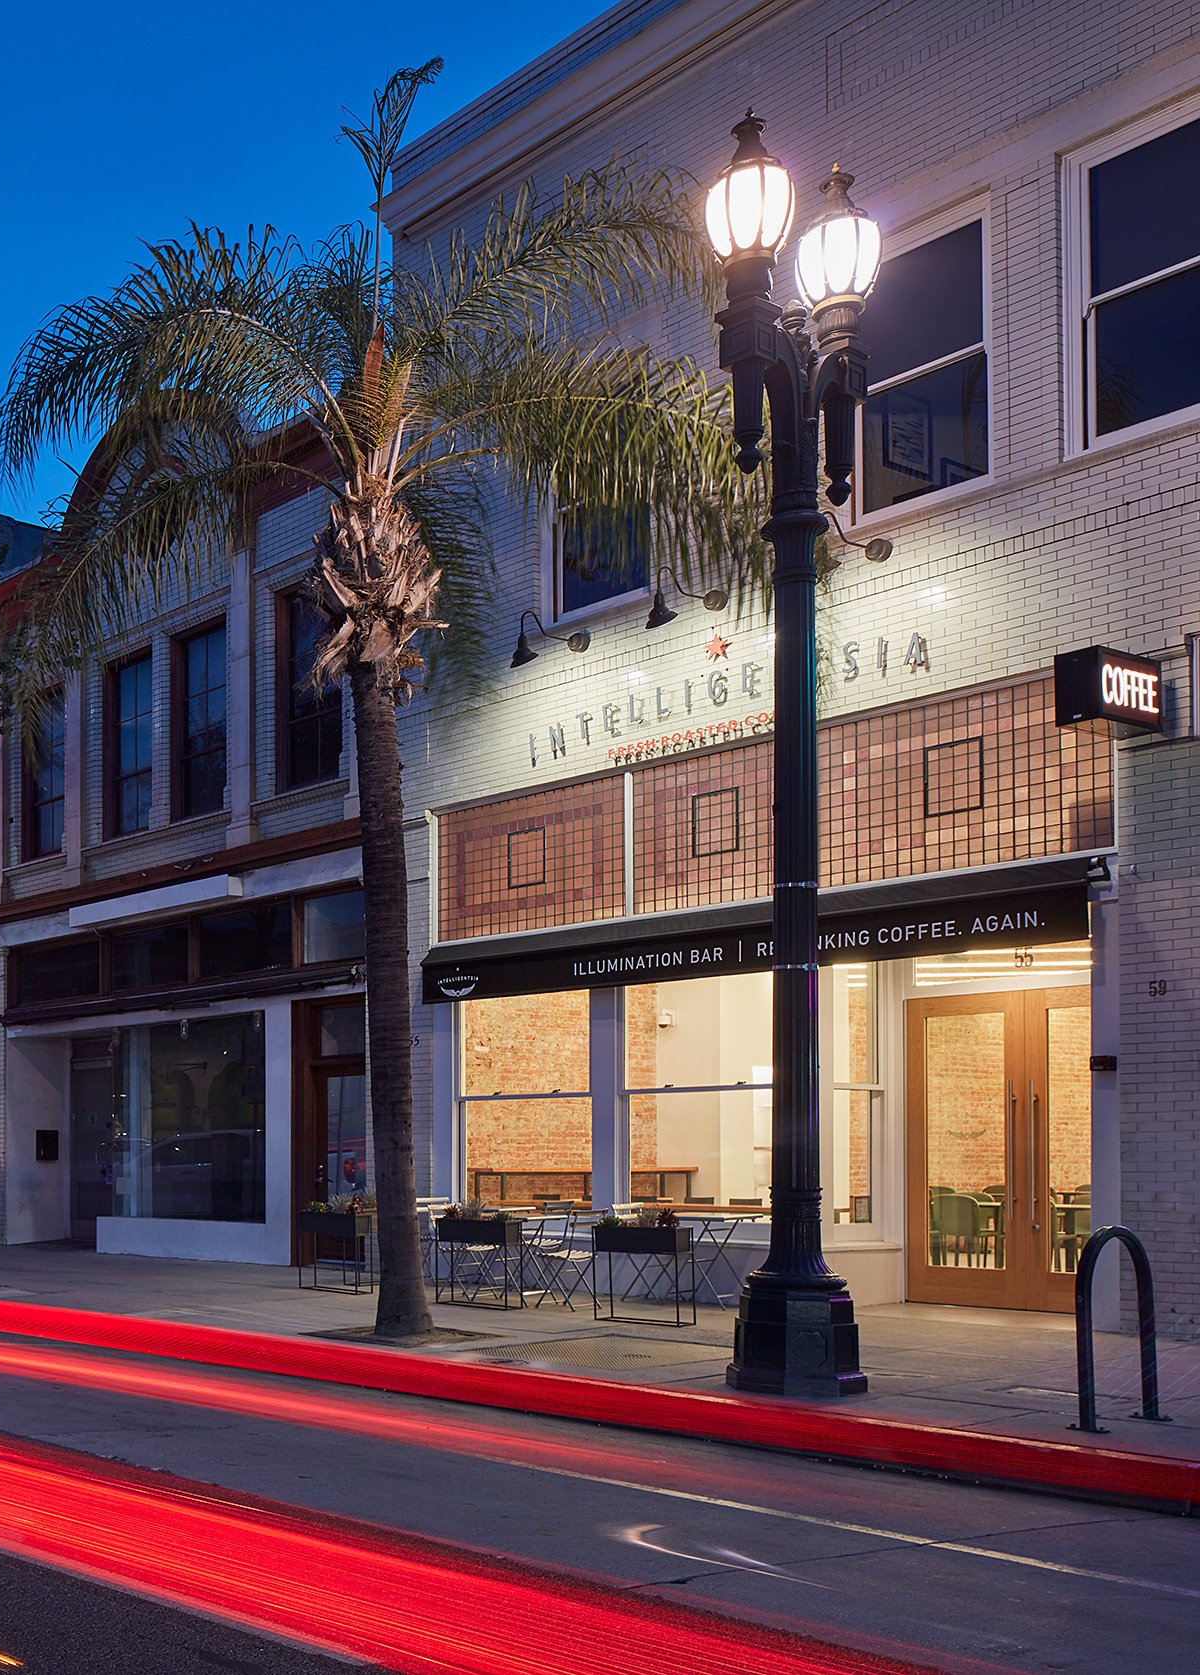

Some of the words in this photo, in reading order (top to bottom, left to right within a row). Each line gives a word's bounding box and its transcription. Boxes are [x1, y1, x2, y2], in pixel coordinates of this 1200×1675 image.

[528, 632, 927, 766] INTELLIGESIA
[1101, 663, 1160, 714] COFFEE
[607, 738, 656, 759] FRESH
[661, 719, 738, 744] ROASTED
[573, 950, 683, 976] ILLUMINATION
[690, 946, 723, 963] BAR
[757, 930, 870, 957] RENKING
[878, 920, 963, 943] COFFEE.
[971, 910, 1046, 934] AGAIN.
[1014, 946, 1034, 968] 55
[1148, 979, 1167, 997] 59
